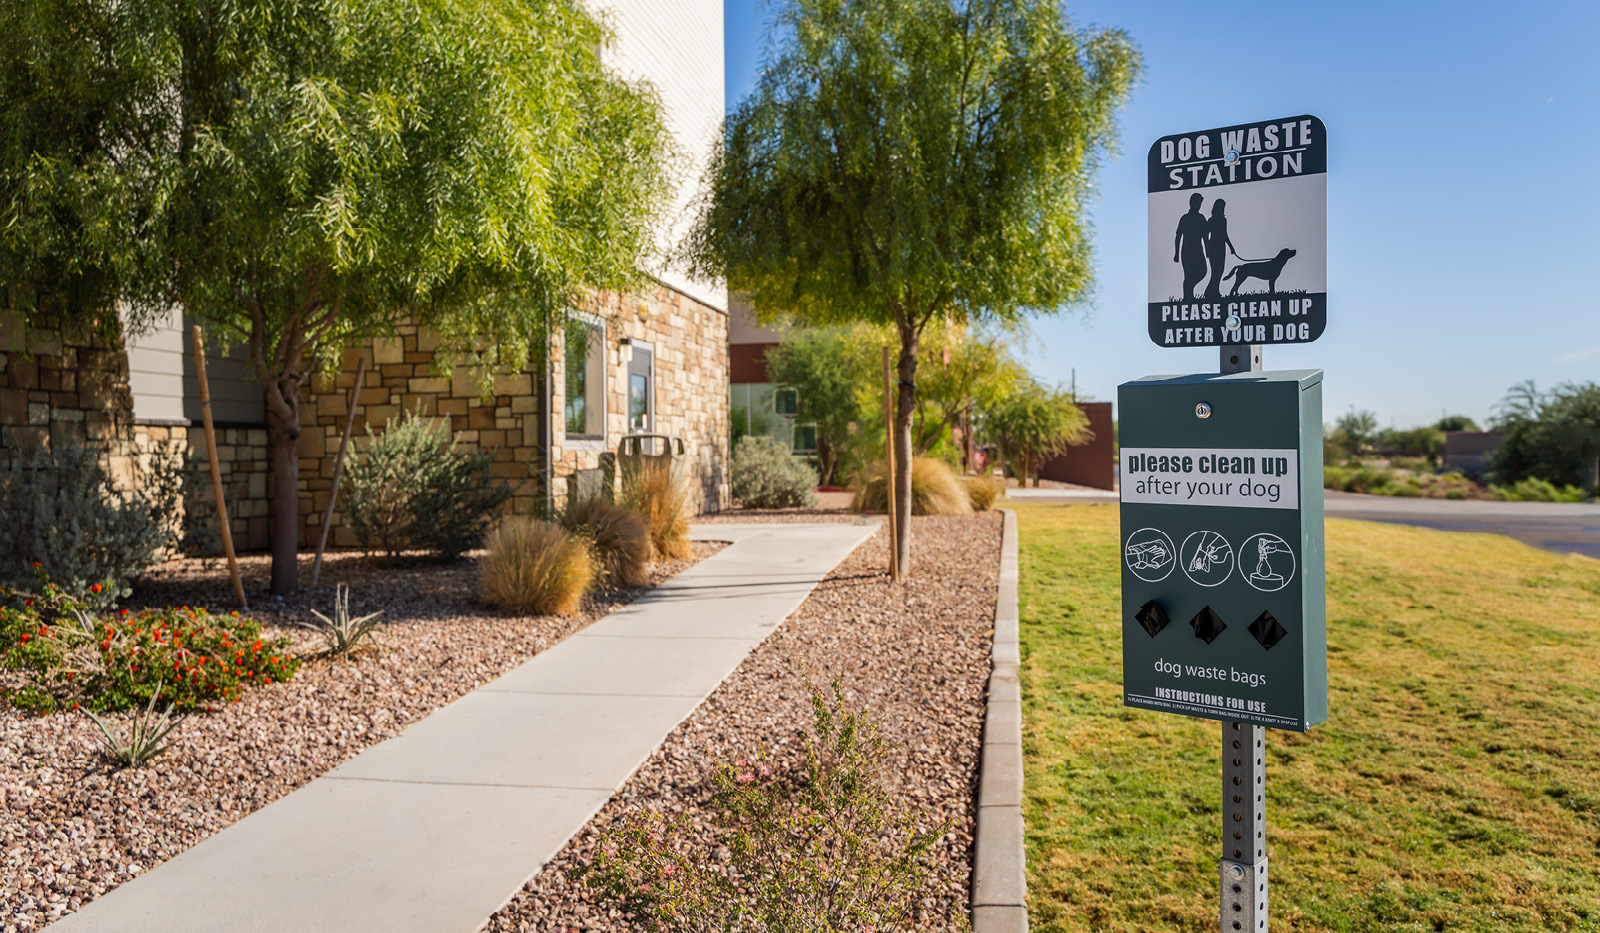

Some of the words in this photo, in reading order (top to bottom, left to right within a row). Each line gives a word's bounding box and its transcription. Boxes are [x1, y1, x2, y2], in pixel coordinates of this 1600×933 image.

[1160, 135, 1210, 164] DOG
[1220, 119, 1312, 155] WASTE
[1169, 152, 1303, 189] STATION
[1161, 303, 1221, 322] PLEASE
[1227, 300, 1281, 318] CLEAN
[1288, 298, 1312, 316] UP
[1164, 326, 1214, 344] AFTER
[1220, 324, 1266, 343] YOUR
[1273, 322, 1310, 341] DOG
[1128, 453, 1193, 474] please
[1198, 454, 1255, 474] clean
[1261, 456, 1288, 477] up
[1136, 475, 1181, 495] after
[1186, 481, 1232, 499] your
[1239, 478, 1280, 502] dog
[1154, 658, 1182, 678] dog
[1185, 664, 1227, 681] waste
[1231, 667, 1266, 688] bags
[1155, 687, 1224, 707] INSTRUCTIONS
[1226, 697, 1245, 710] FOR
[1247, 700, 1266, 713] USE
